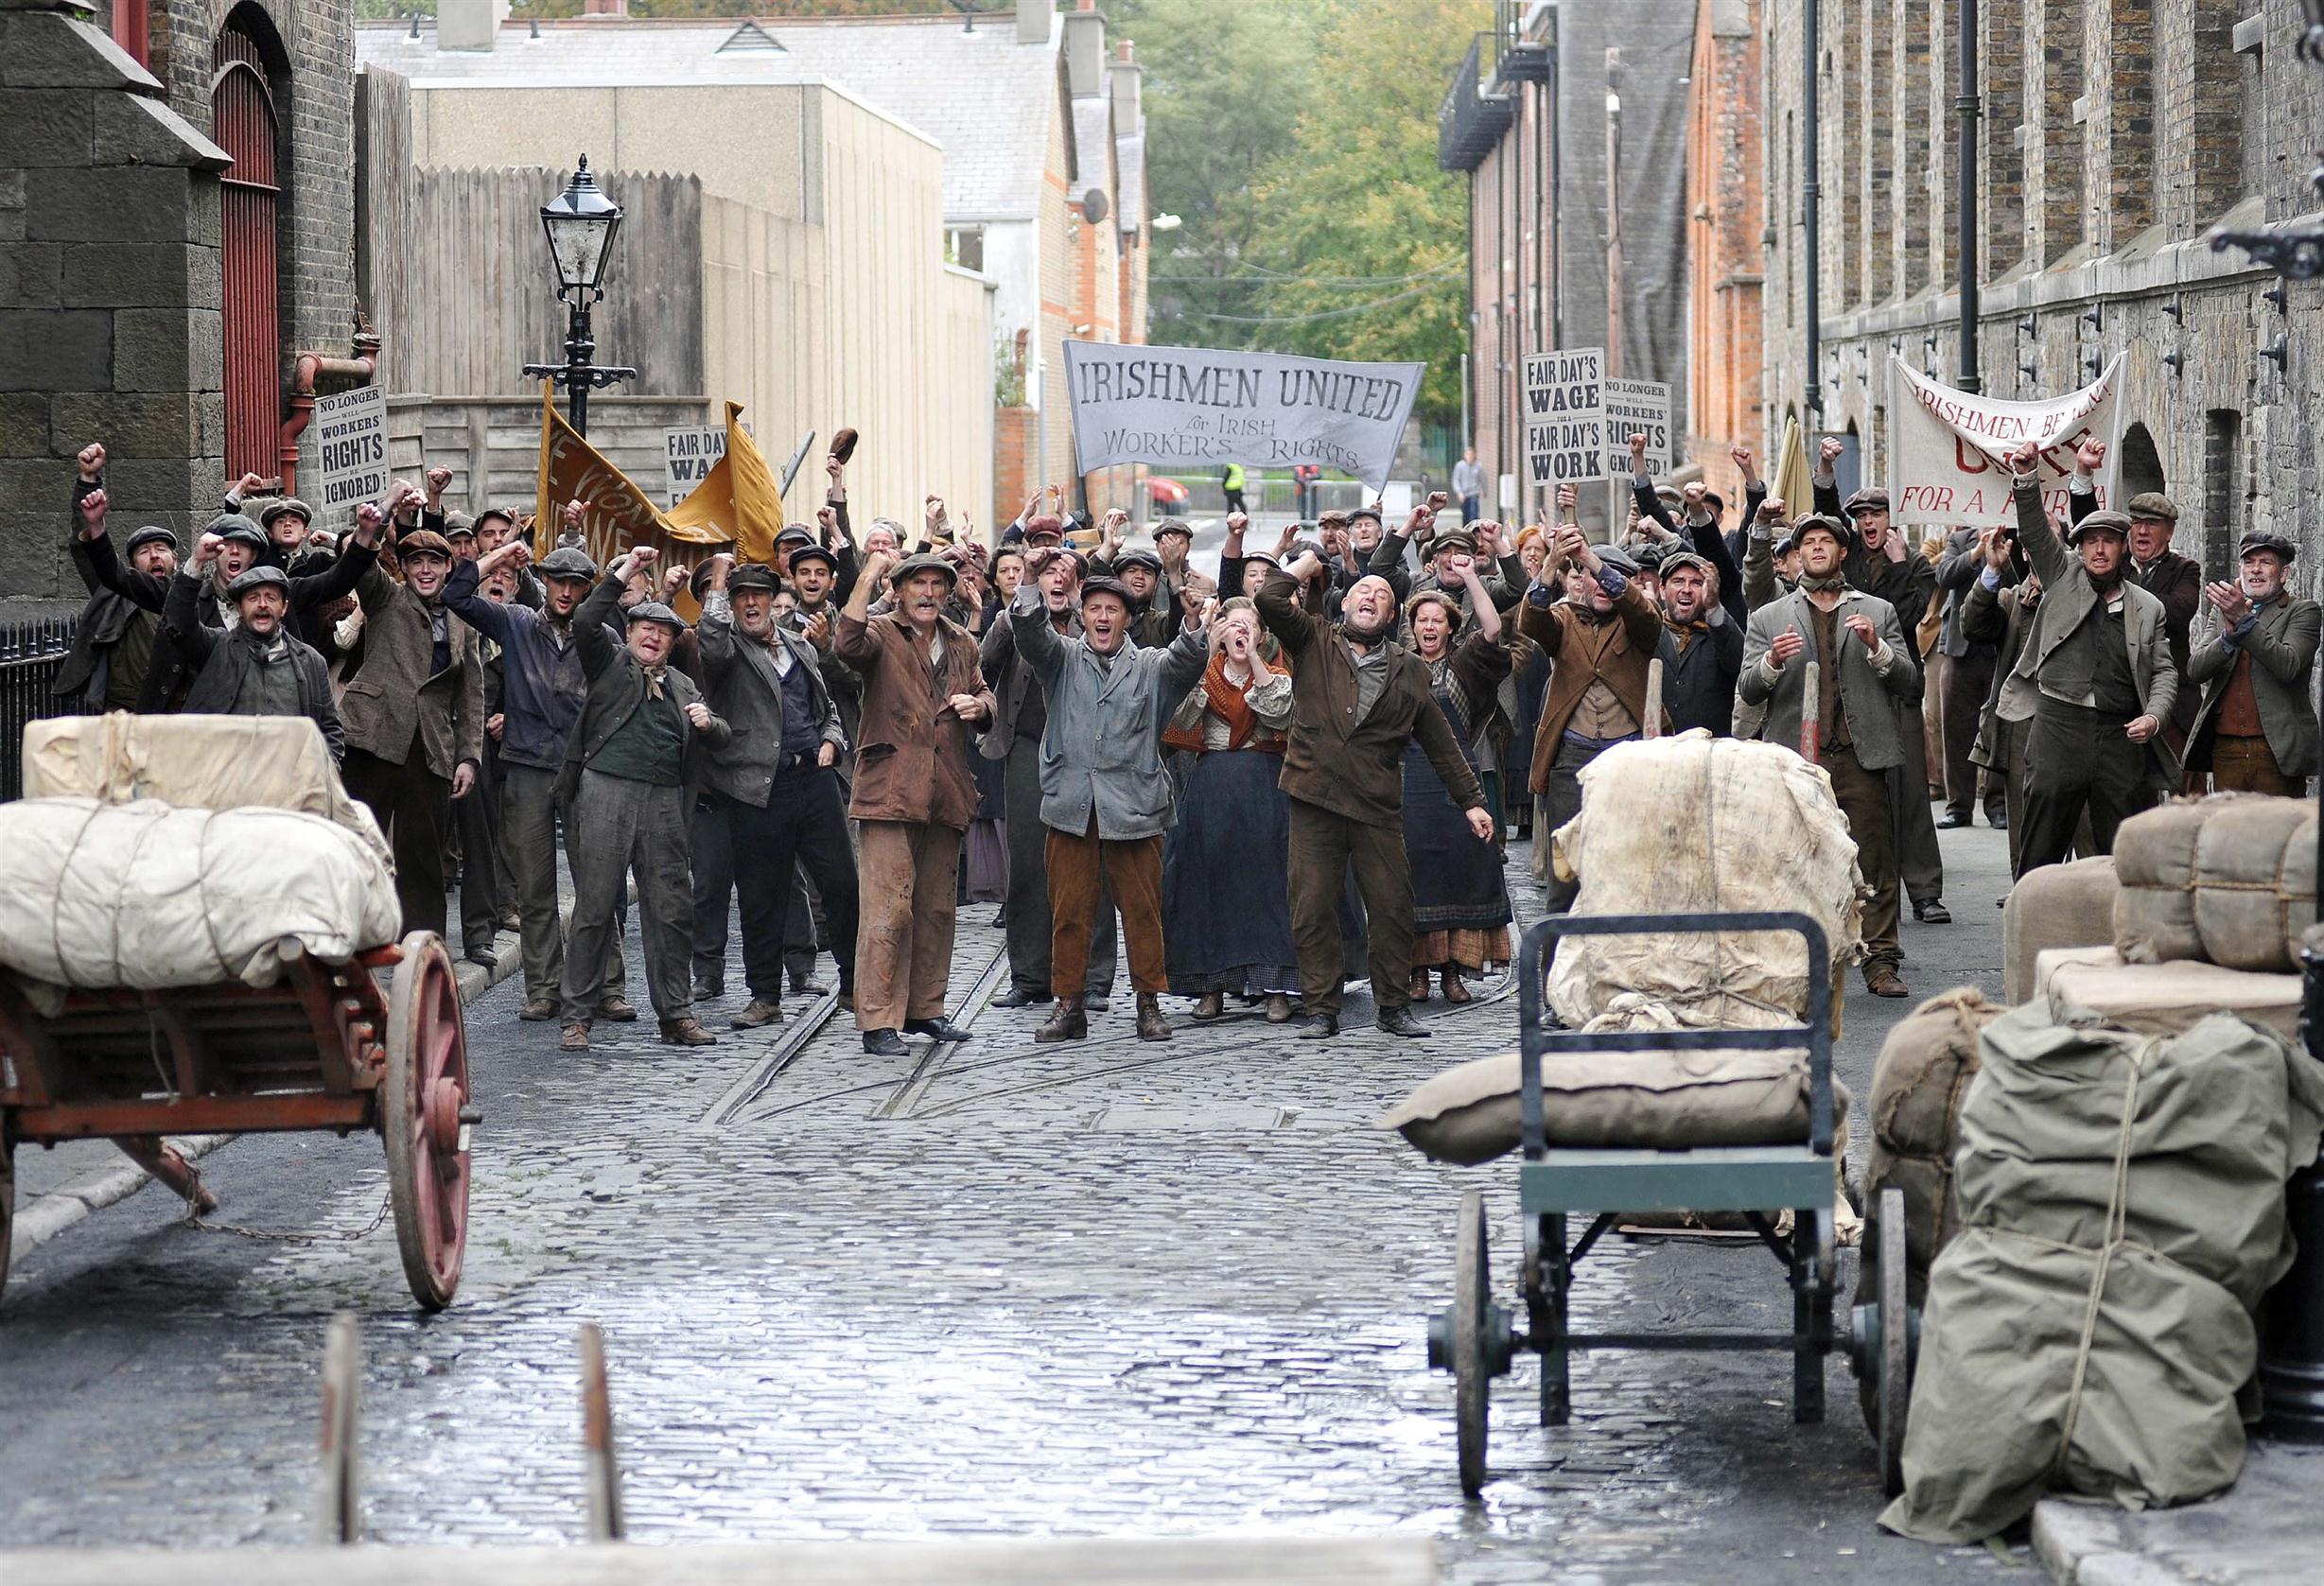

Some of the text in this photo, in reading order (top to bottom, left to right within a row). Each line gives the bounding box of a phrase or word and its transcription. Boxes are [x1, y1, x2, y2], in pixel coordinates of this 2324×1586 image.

[1528, 356, 1597, 386] FAIR DAY'S
[320, 389, 379, 413] NO LONGER
[1078, 360, 1403, 422] IRISHMEN UNITED
[1529, 384, 1599, 413] WAGE
[1605, 381, 1665, 397] NO LONGER
[341, 410, 359, 419] WILL
[1174, 413, 1277, 436] for IRISH
[1606, 404, 1667, 421] WORKERS'
[1914, 384, 2032, 440] IRISHMEN
[2041, 412, 2065, 438] BE
[322, 414, 382, 440] WORKERS'
[1530, 422, 1599, 451] FAIR DAY'S
[323, 432, 383, 473] RIGHTS
[668, 434, 700, 456] FAIR
[1104, 427, 1360, 470] WORKER'S RIGHTS
[1530, 450, 1601, 480] WORK
[1610, 454, 1667, 477] GNOED!
[1898, 485, 1953, 513] FOR
[1962, 489, 1984, 514] A
[2001, 489, 2069, 515] FIR
